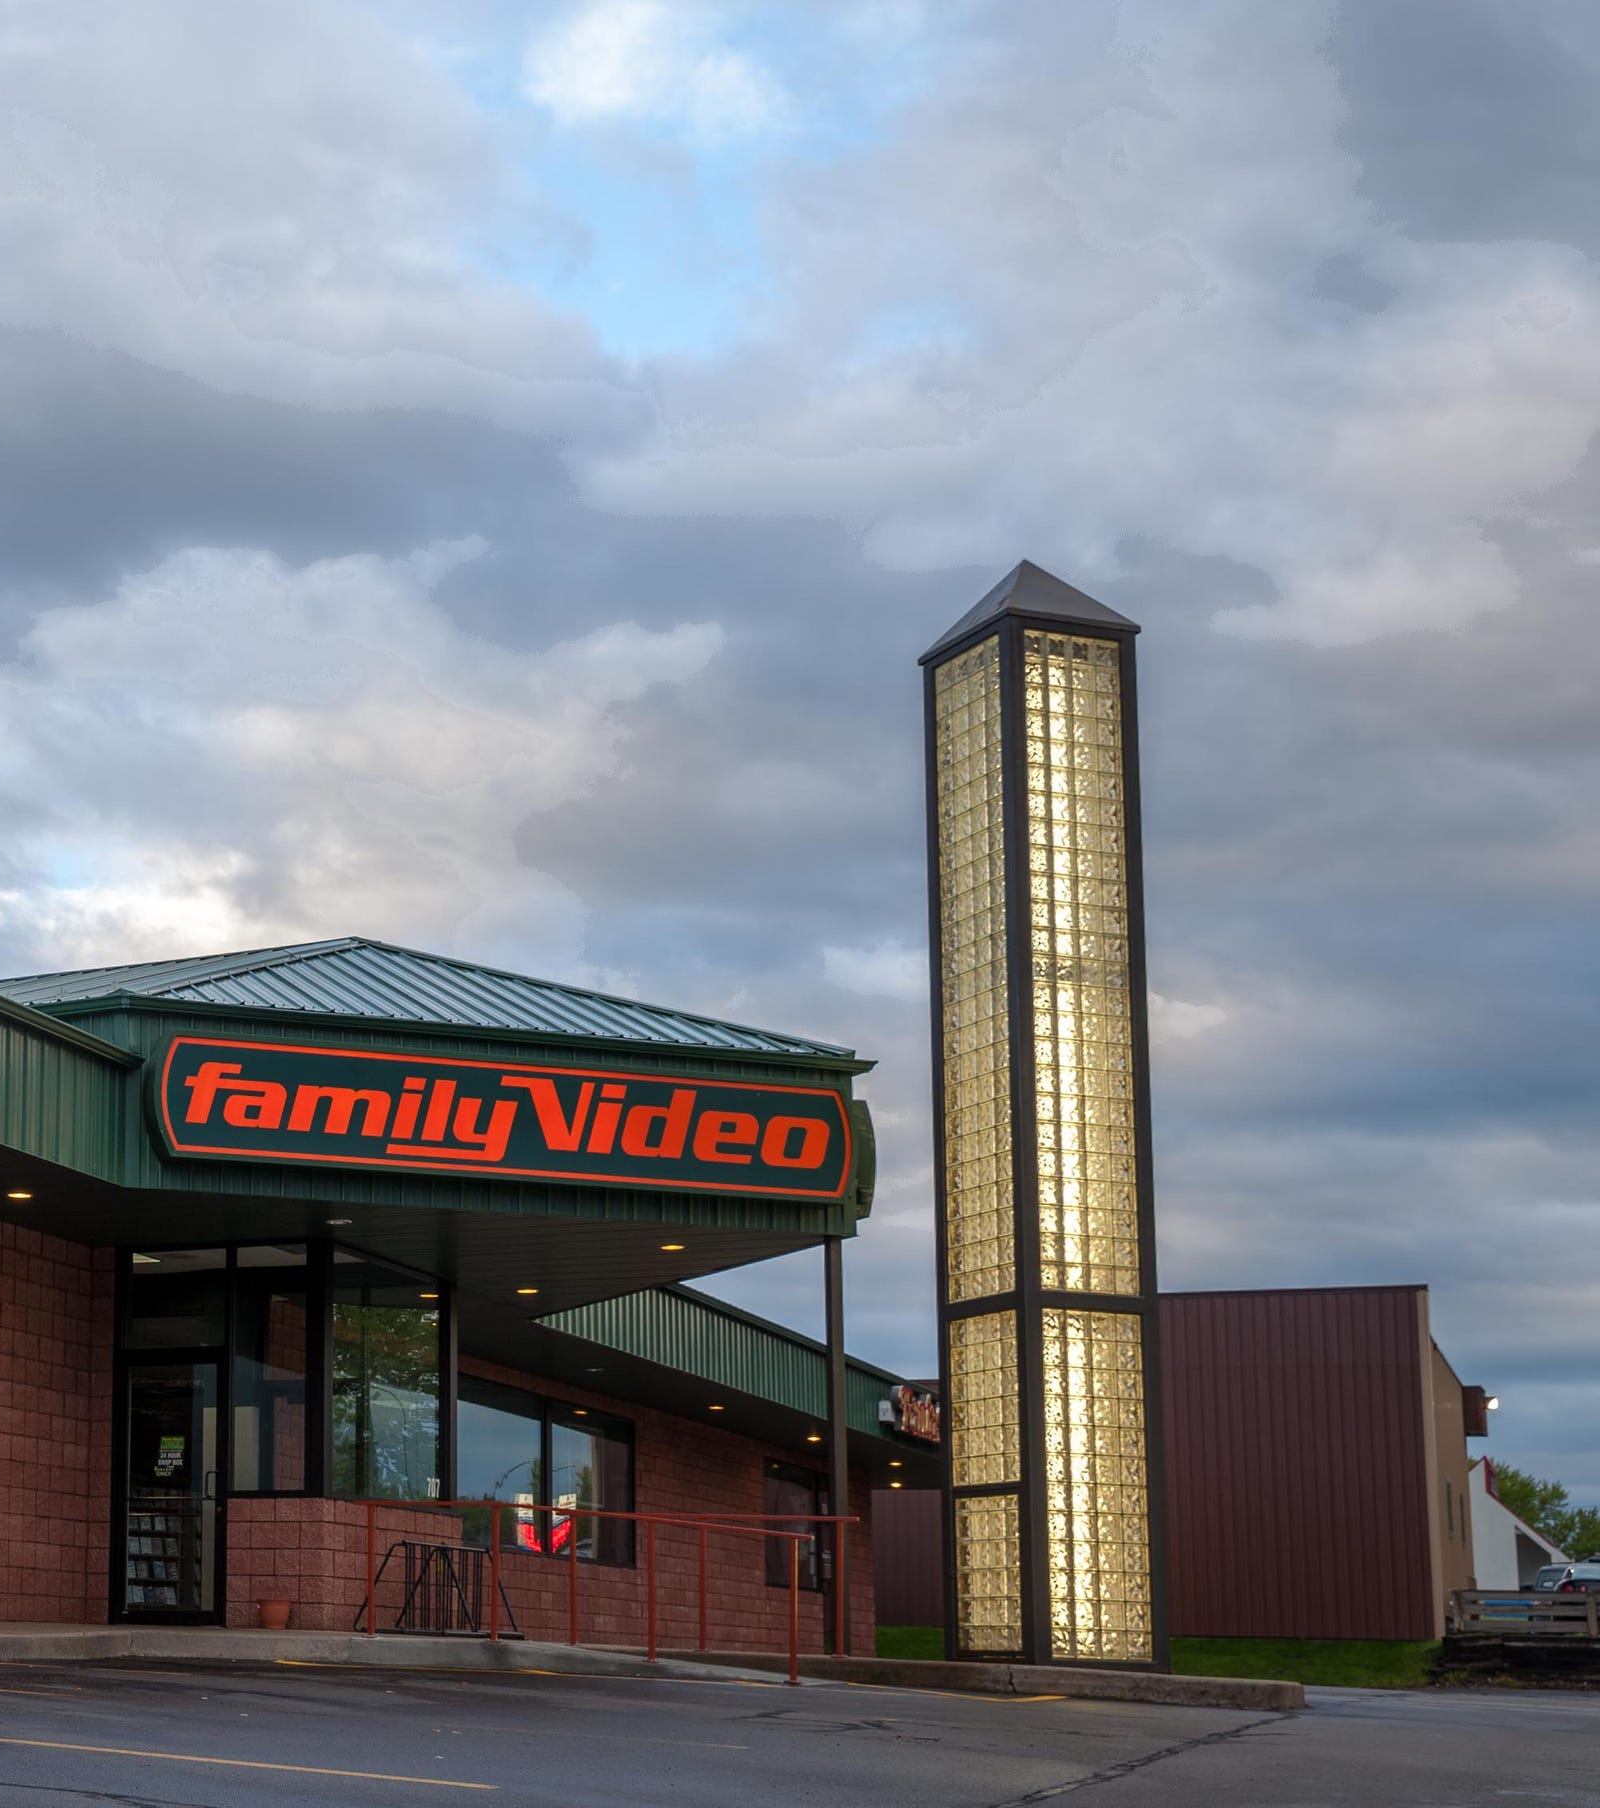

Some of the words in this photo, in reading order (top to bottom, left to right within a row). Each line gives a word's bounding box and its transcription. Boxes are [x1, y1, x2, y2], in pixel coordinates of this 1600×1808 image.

[184, 1060, 518, 1163] family
[501, 1074, 831, 1170] Video
[426, 1477, 441, 1499] 707
